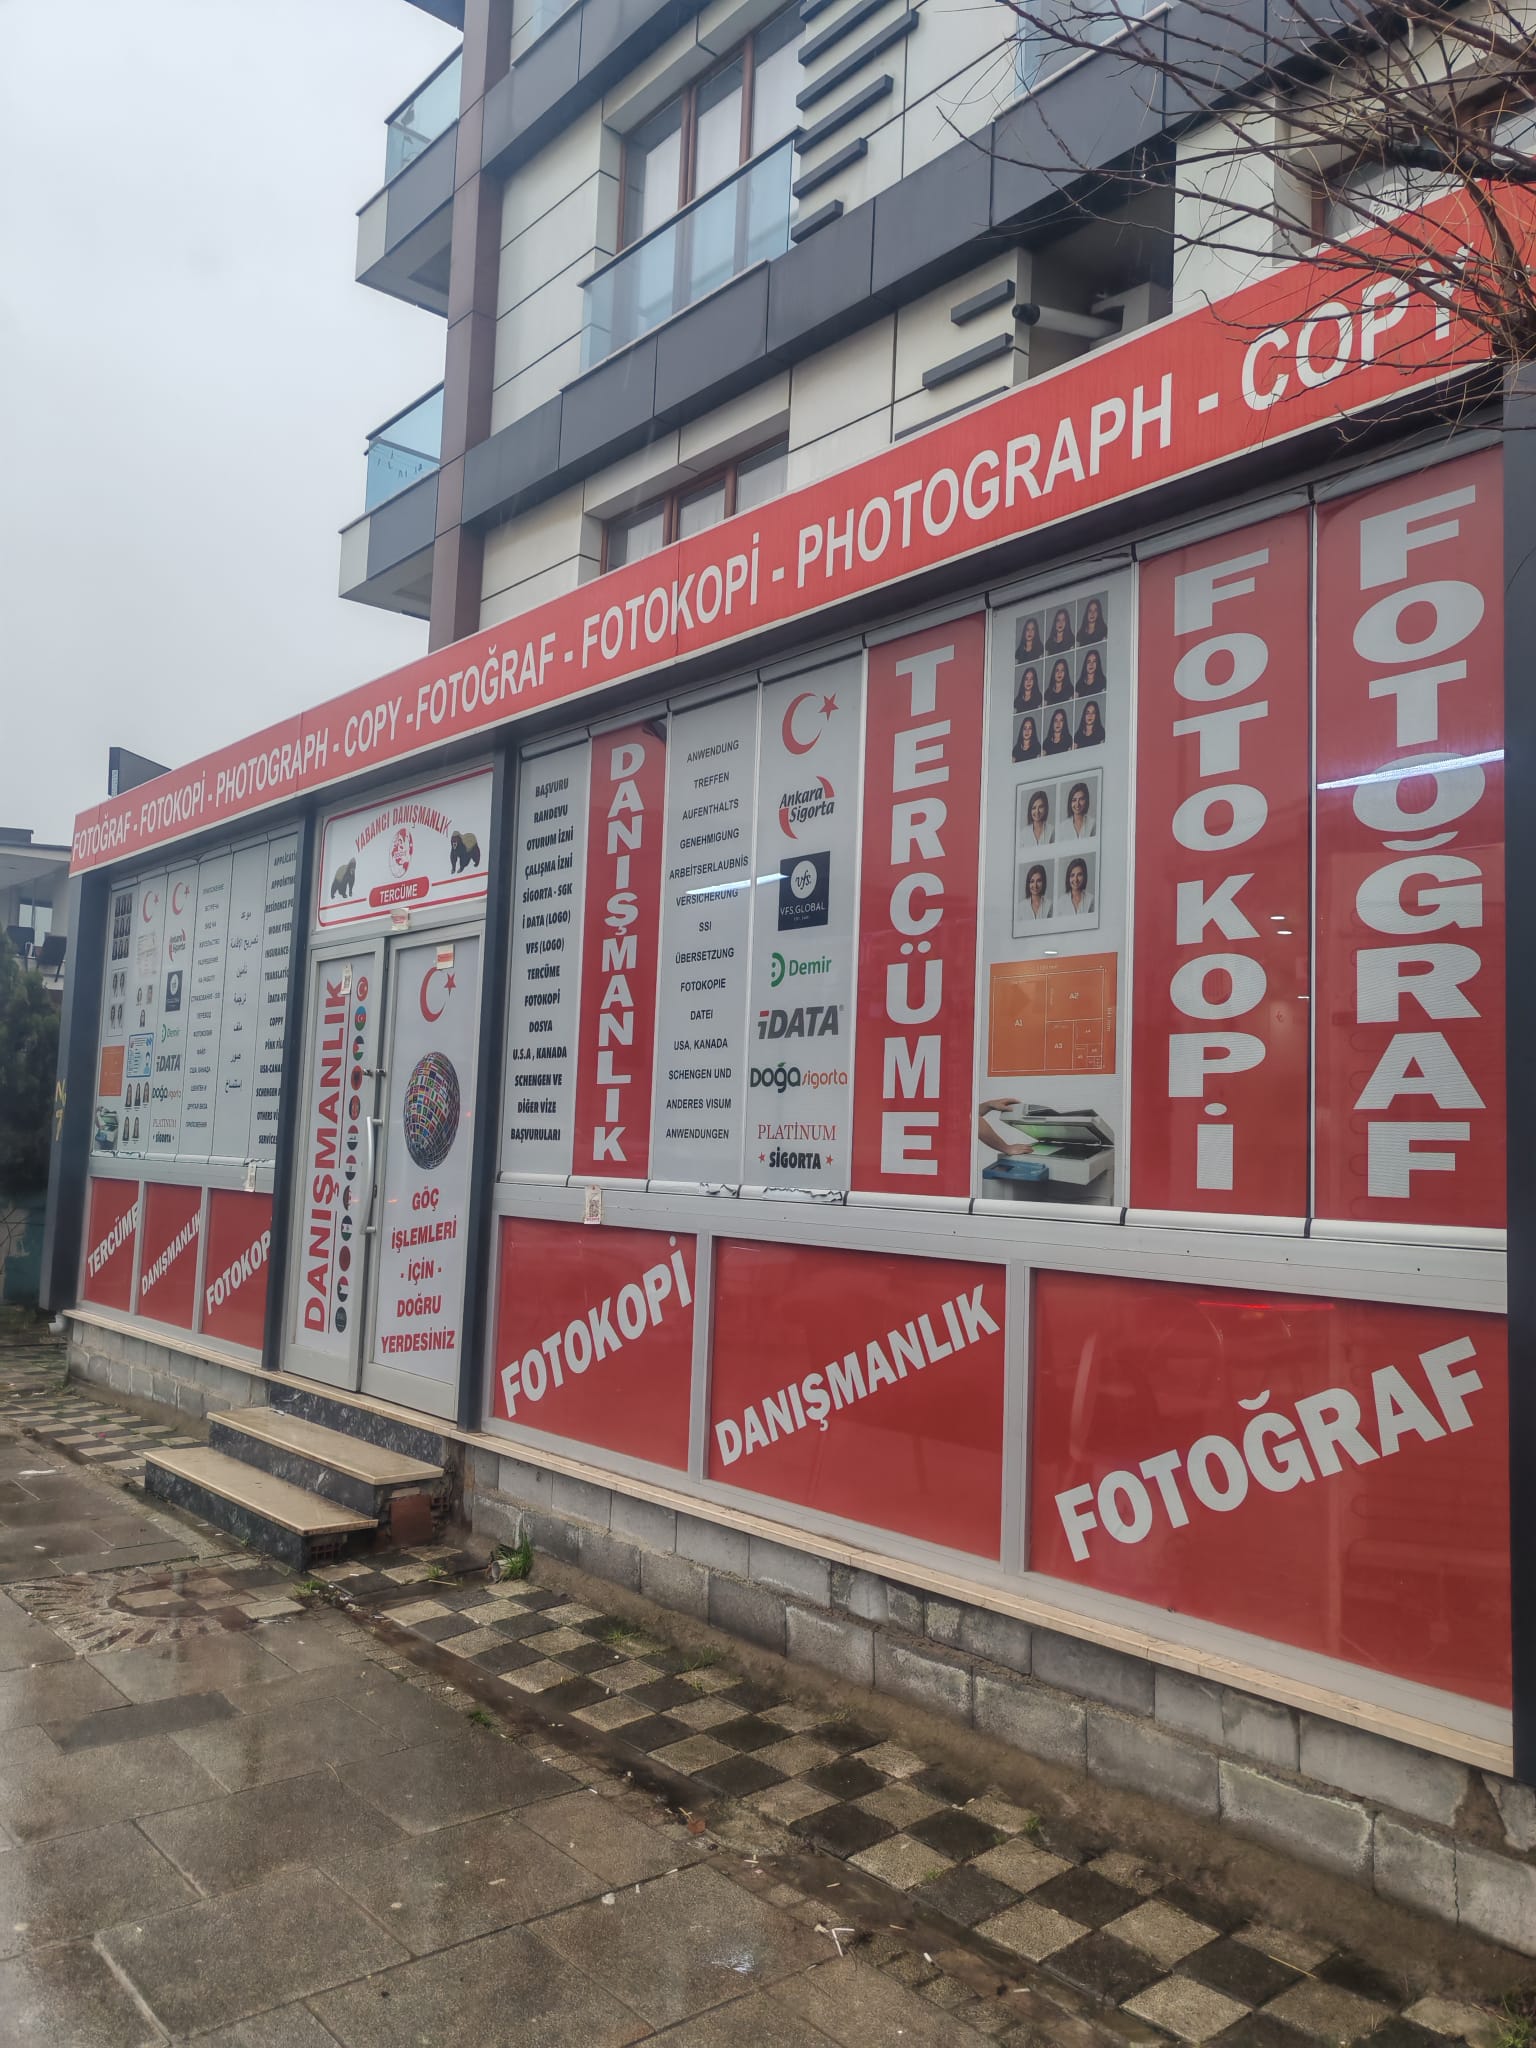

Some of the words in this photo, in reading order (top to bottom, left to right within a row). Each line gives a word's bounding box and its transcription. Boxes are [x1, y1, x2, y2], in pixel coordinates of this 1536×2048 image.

[72, 812, 131, 862] FOTOĞRAF
[140, 770, 206, 836] FOTOKOPİ
[216, 728, 328, 807] PHOTOGRAPH
[344, 696, 402, 757] COPY
[416, 632, 556, 730] FOTOĞRAF
[582, 533, 760, 668] FOTOKOPİ
[797, 373, 1173, 589] PHOTOGRAPH
[1242, 242, 1474, 411] COPY
[687, 740, 739, 763] ANWENDUNG
[535, 778, 569, 798] BAŞVURU
[694, 771, 730, 789] TREFFEN
[780, 786, 824, 808] Ankara
[534, 804, 568, 823] RANDEVU
[682, 798, 739, 821] AUFENTHALTS
[789, 801, 835, 823] Sigorta
[355, 811, 390, 853] YABANCI
[393, 804, 453, 838] DANIŞMANLIK
[526, 833, 557, 851] OTURUM
[558, 826, 574, 844] İZNİ
[680, 828, 740, 849] GENEHMIGUNG
[1352, 484, 1486, 1199] FOTOĞRAF
[525, 861, 556, 880] ÇALIŞMA
[557, 852, 573, 870] İZNİ
[669, 854, 749, 880] ARBEİTSERLAUBNİS
[1168, 548, 1269, 1191] FOTOKOPİ
[380, 883, 418, 904] TERCÜME
[522, 887, 552, 903] SİGORTA
[557, 882, 573, 896] SGK
[676, 887, 739, 907] VERSICHERUNG
[526, 914, 545, 928] DATA
[545, 909, 571, 926] (LOGO)
[881, 645, 955, 1175] TERCÜME
[699, 920, 712, 933] SSI
[525, 941, 539, 954] VFS
[539, 937, 565, 953] (LOGO)
[592, 743, 646, 1162] DANIŞMANLIK
[675, 947, 734, 964] ÜBERSETZUNG
[527, 963, 560, 980] TERCÜME
[789, 956, 832, 976] Demir
[680, 978, 726, 992] FOTOKOPIE
[524, 988, 561, 1007] FOTOKOPİ
[690, 1009, 713, 1021] DATEI
[528, 1020, 553, 1033] DOSYA
[536, 1046, 567, 1059] KANADA
[694, 1037, 728, 1049] KANADA
[515, 1074, 551, 1087] SCHENGEN
[552, 1074, 562, 1086] VE
[668, 1069, 712, 1080] SCHENGEN
[714, 1068, 731, 1079] UND
[517, 1097, 539, 1113] DİĞER
[540, 1097, 557, 1113] VİZE
[666, 1098, 704, 1109] ANDERES
[706, 1097, 731, 1109] VISUM
[510, 1128, 560, 1144] BAŞVURULARI
[666, 1128, 729, 1140] ANWENDUNGEN
[758, 1121, 837, 1141] PLATİNUM
[304, 979, 347, 1333] DANIŞMANLIK
[411, 1187, 439, 1211] GÖÇ
[391, 1215, 457, 1250] İŞLEMLERİ
[407, 1257, 434, 1286] İÇİN
[396, 1294, 442, 1318] DOĞRU
[500, 1235, 693, 1420] FOTOKOPİ
[380, 1329, 456, 1354] YERDESİNİZ
[714, 1282, 1000, 1469] DANIŞMANLIK
[1054, 1334, 1484, 1564] FOTOĞRAF
